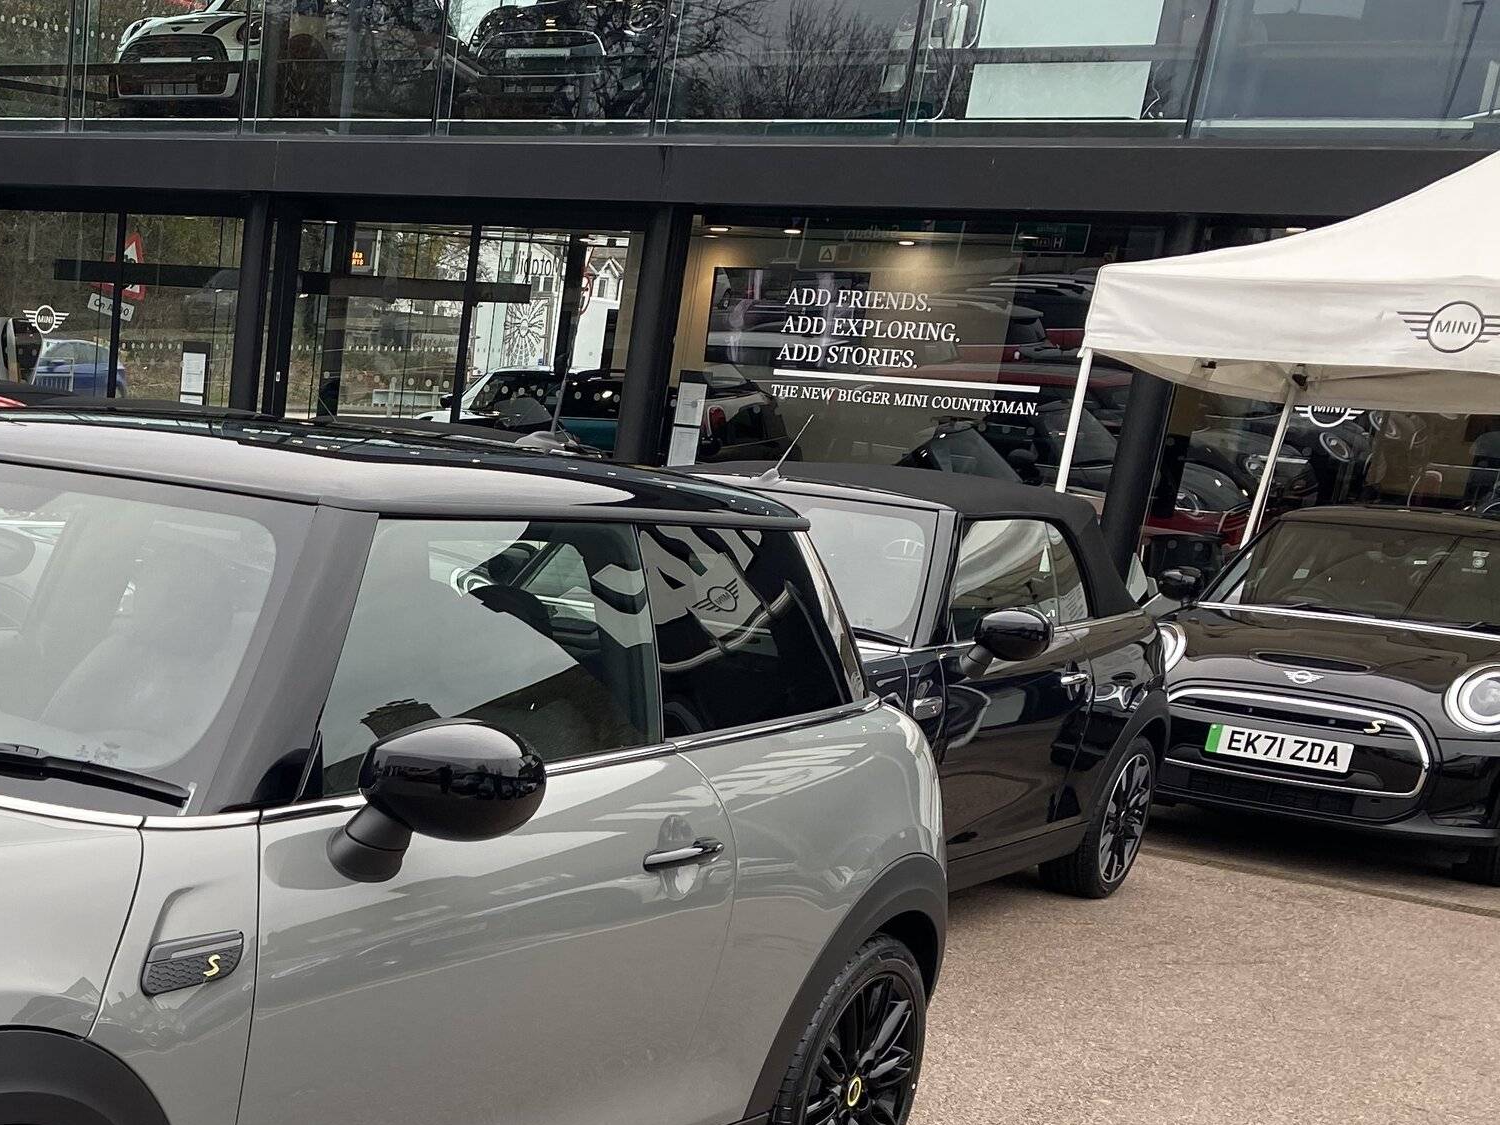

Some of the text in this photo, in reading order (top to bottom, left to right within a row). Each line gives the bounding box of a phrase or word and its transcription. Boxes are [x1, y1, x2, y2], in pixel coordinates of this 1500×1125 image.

[785, 288, 932, 313] ADD FRIENDS.
[38, 315, 53, 323] MINI
[781, 315, 961, 343] ADD EXPLORING.
[1434, 320, 1477, 336] MINI
[776, 344, 918, 369] ADD STORIES.
[771, 384, 1040, 416] THE NEW BIGGER MINI COUNTRYMAN.
[1363, 719, 1387, 734] S
[1227, 730, 1339, 767] EK71 ZDA
[203, 954, 221, 977] S
